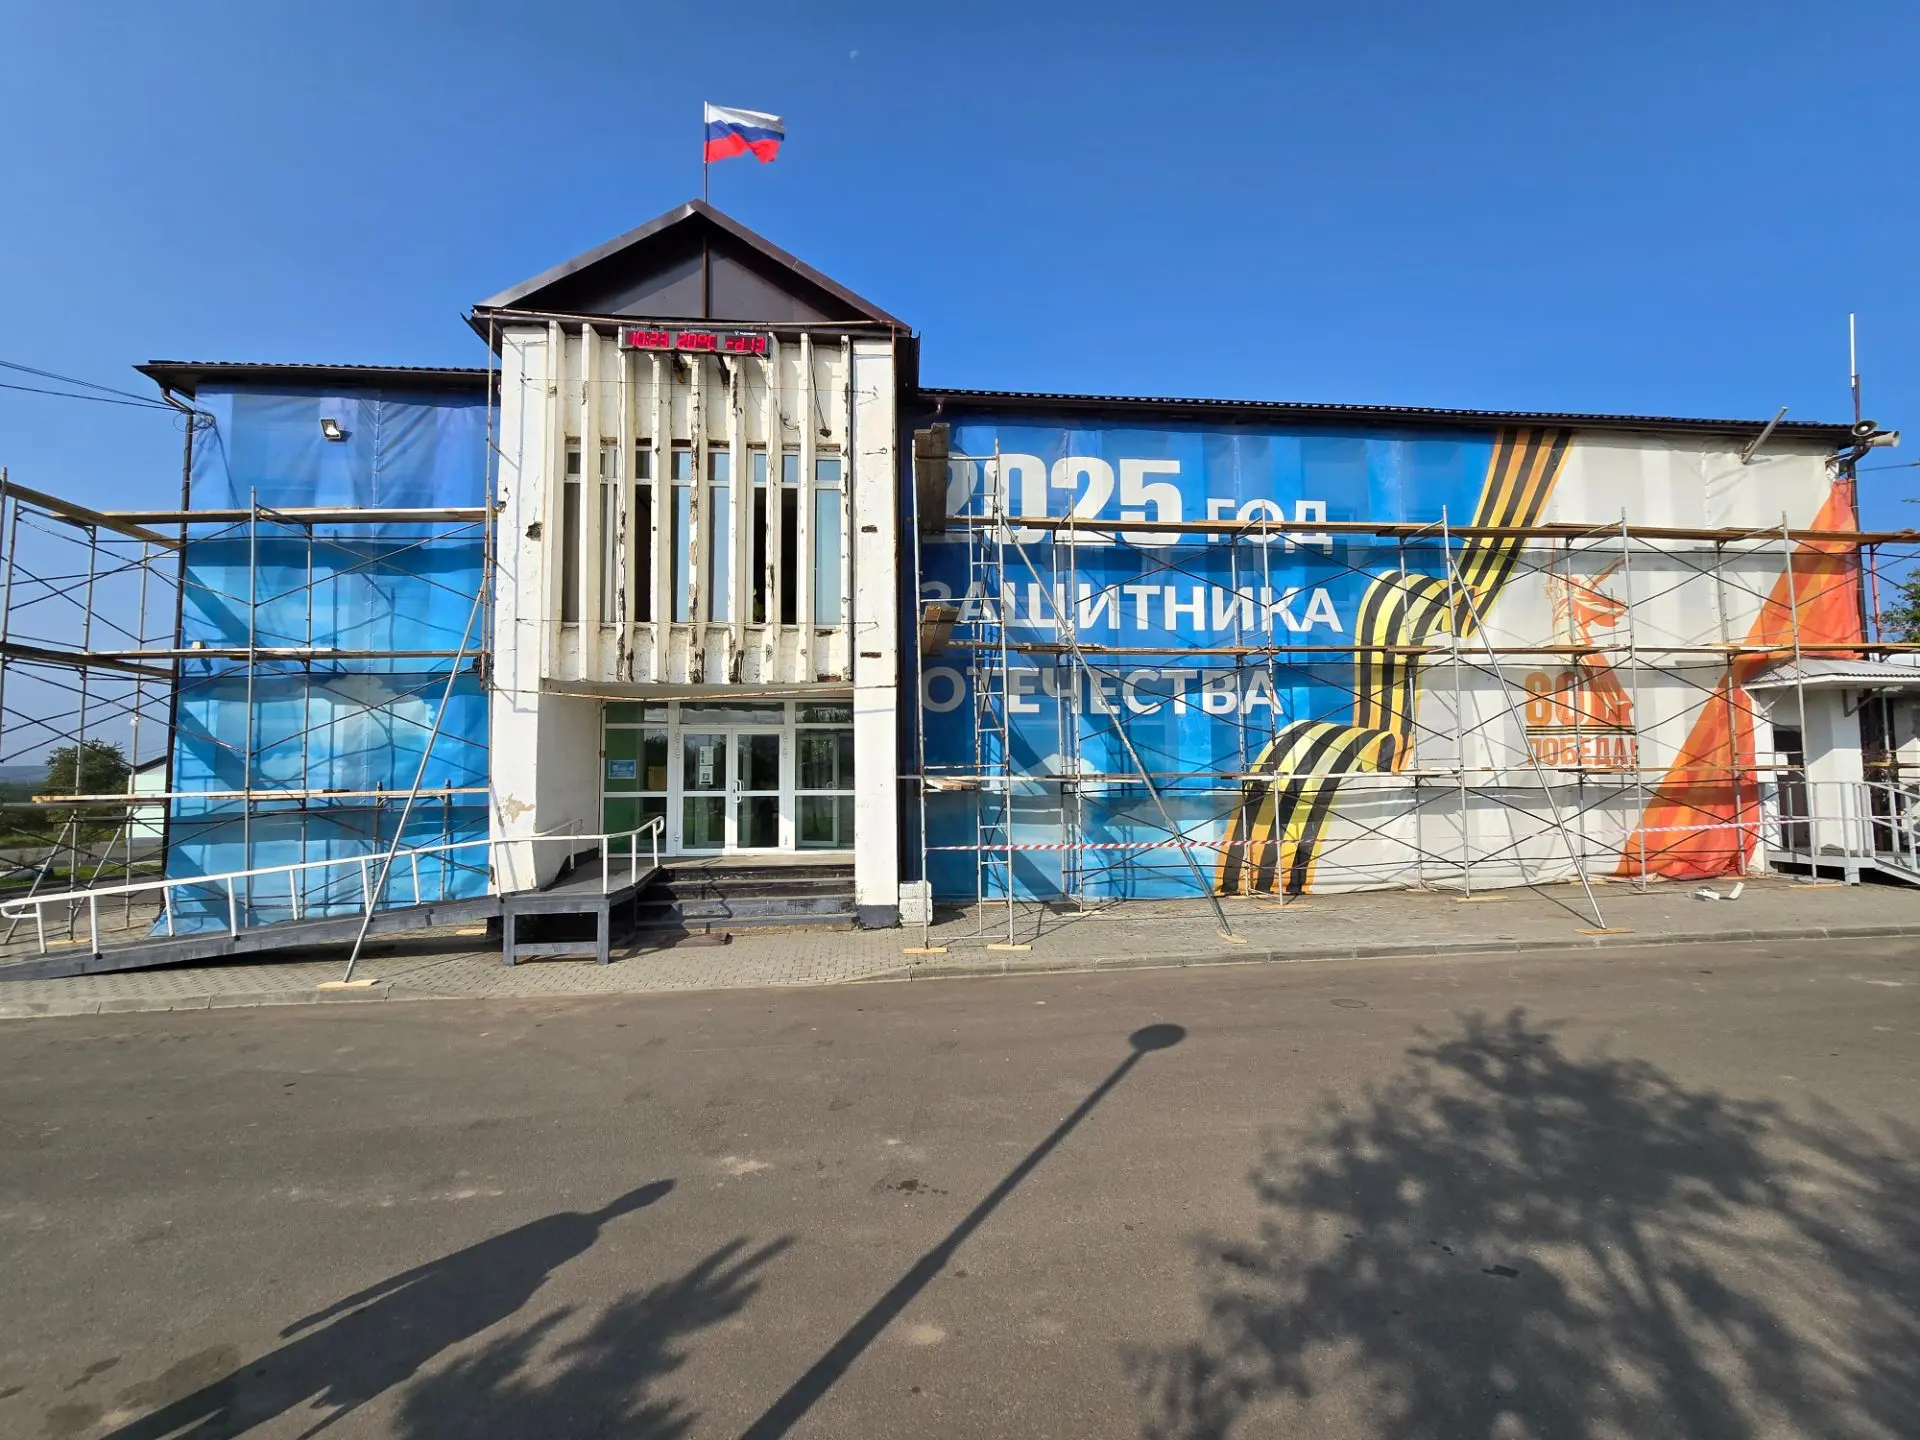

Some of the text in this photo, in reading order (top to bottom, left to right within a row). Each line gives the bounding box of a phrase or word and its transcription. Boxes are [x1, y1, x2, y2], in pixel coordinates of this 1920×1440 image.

[1207, 498, 1333, 554] ГОД
[921, 666, 1284, 716] ОТЕЧЕСТВА
[1525, 671, 1585, 726] 80
[1527, 737, 1637, 766] ПОБЕДА!
